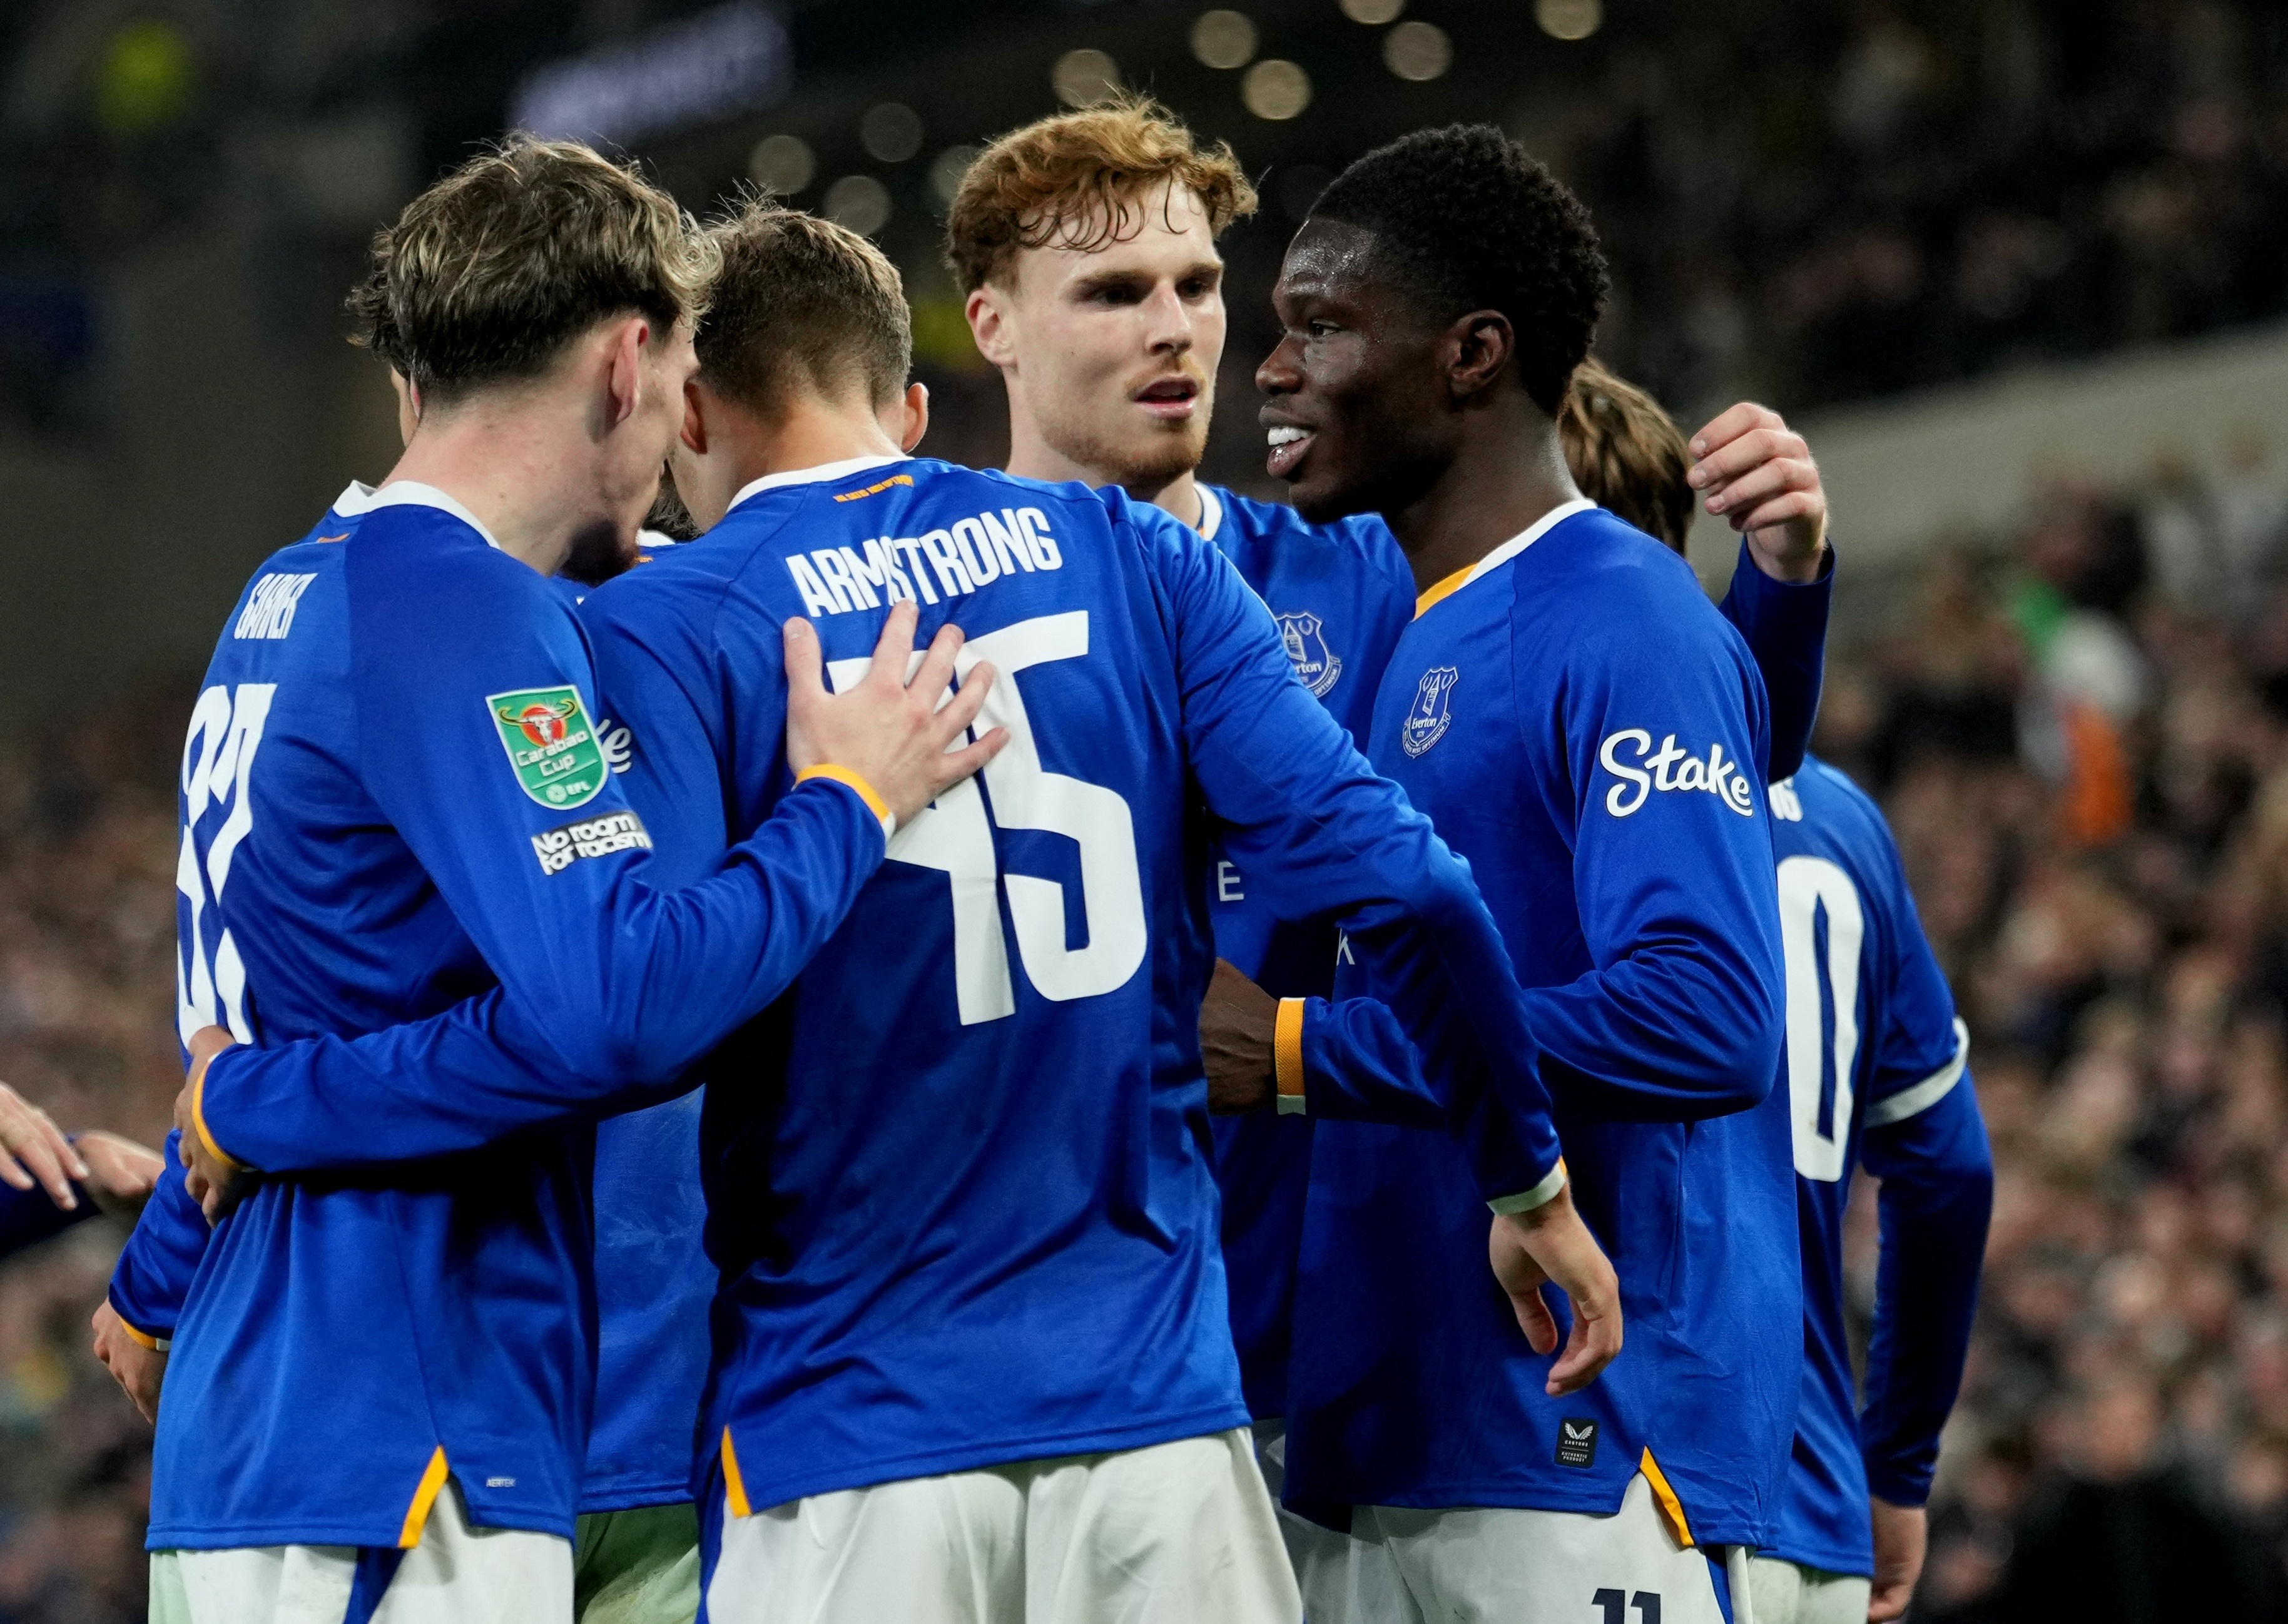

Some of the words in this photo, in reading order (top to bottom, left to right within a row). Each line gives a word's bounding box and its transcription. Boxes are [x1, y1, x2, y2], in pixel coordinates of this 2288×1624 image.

[786, 508, 1063, 617] ARMSTRONG
[1411, 717, 1437, 729] Everton
[516, 730, 589, 767] Carabao
[538, 753, 576, 777] Cup
[1600, 729, 1754, 818] Stake
[531, 831, 570, 855] No
[568, 815, 638, 841] room
[827, 610, 1148, 1026] 45
[537, 845, 576, 876] for
[575, 831, 654, 858] racism
